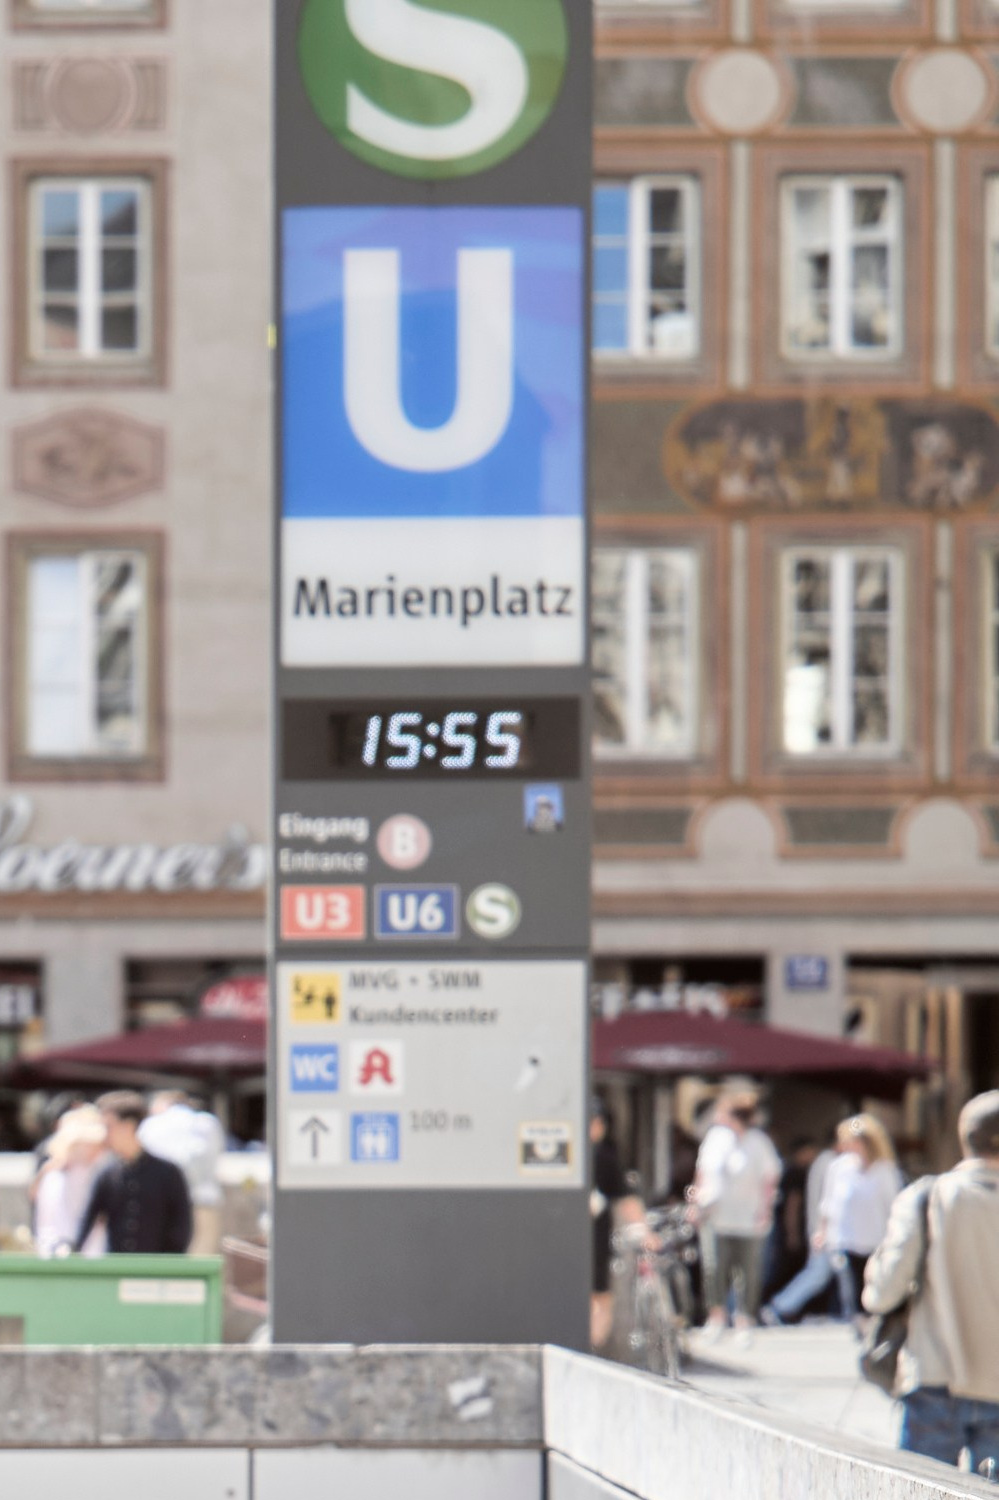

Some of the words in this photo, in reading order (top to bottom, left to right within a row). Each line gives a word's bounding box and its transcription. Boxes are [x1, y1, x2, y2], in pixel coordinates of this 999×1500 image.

[344, 0, 529, 161] S
[343, 248, 514, 473] U
[293, 576, 573, 628] Marienplatz
[362, 711, 522, 769] 15:55
[280, 813, 369, 843] Eingang
[391, 823, 418, 859] B
[280, 848, 367, 873] Entrance
[295, 892, 350, 930] U3
[387, 892, 446, 932] U6
[473, 885, 513, 938] S
[350, 970, 398, 989] MVG
[428, 970, 481, 989] SWM
[350, 1006, 498, 1024] Kundencenter
[293, 1054, 335, 1082] WC
[411, 1110, 446, 1131] 100
